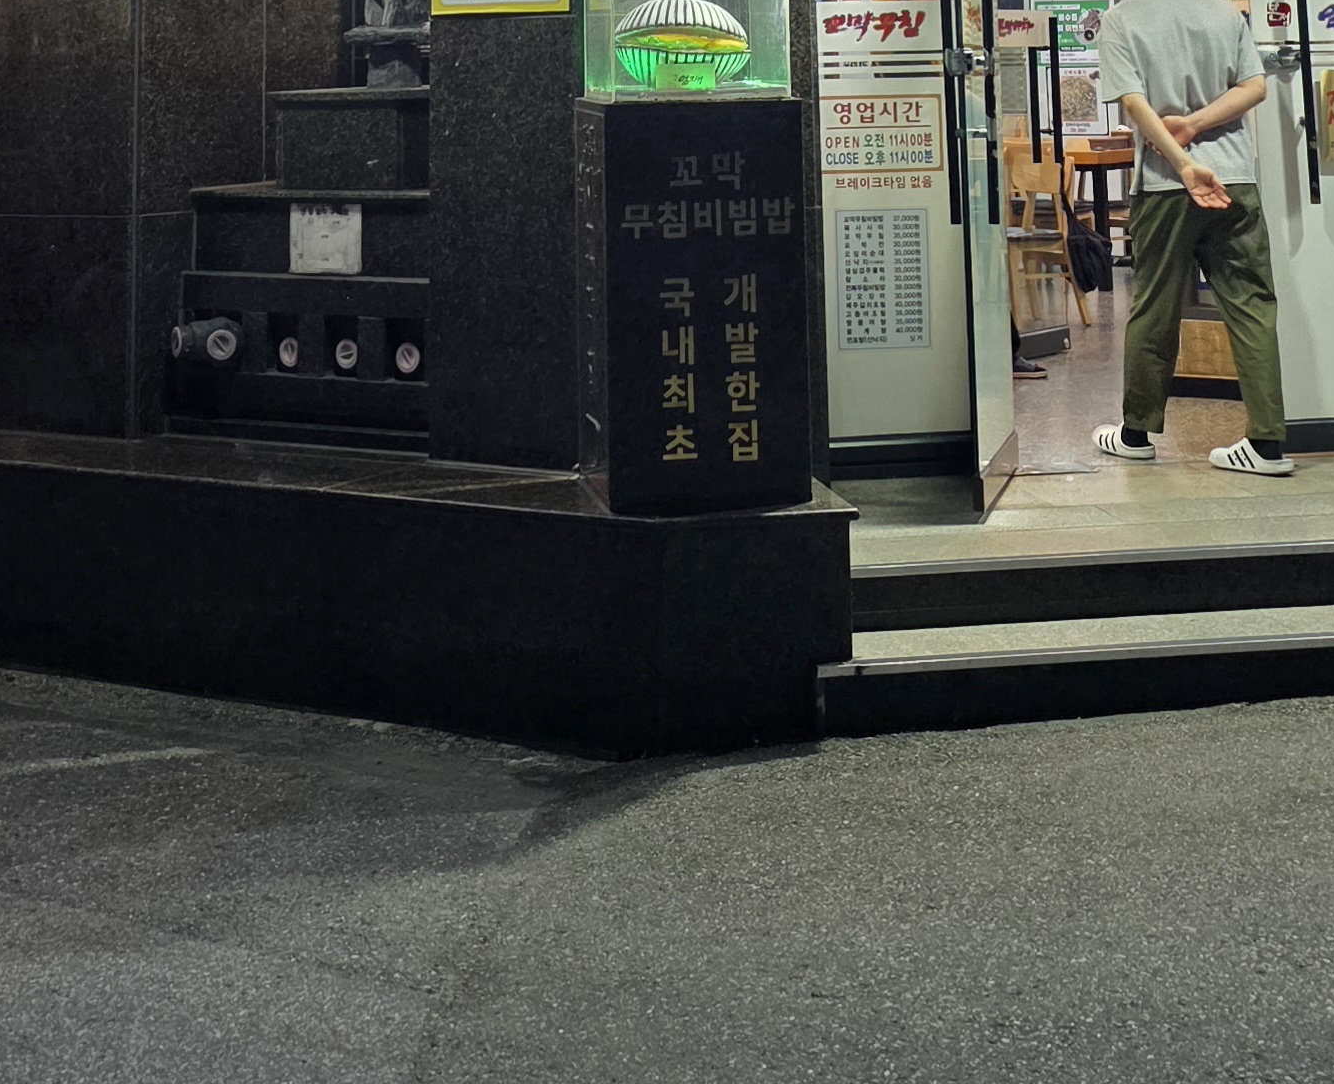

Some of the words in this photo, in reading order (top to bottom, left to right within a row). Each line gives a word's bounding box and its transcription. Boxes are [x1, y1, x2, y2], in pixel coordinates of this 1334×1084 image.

[823, 9, 926, 42] 꼬막무침
[833, 101, 923, 125] 영업시간
[825, 136, 860, 148] OPEN
[864, 133, 885, 147] 오전
[889, 133, 933, 147] 11시00분
[826, 152, 859, 165] CLOSE
[864, 151, 885, 165] 오후
[890, 150, 933, 165] 11시00분
[670, 152, 745, 190] 꼬막
[835, 176, 906, 189] 브레이크타임
[910, 175, 933, 188] 없음
[621, 196, 795, 240] 무침비빔밥
